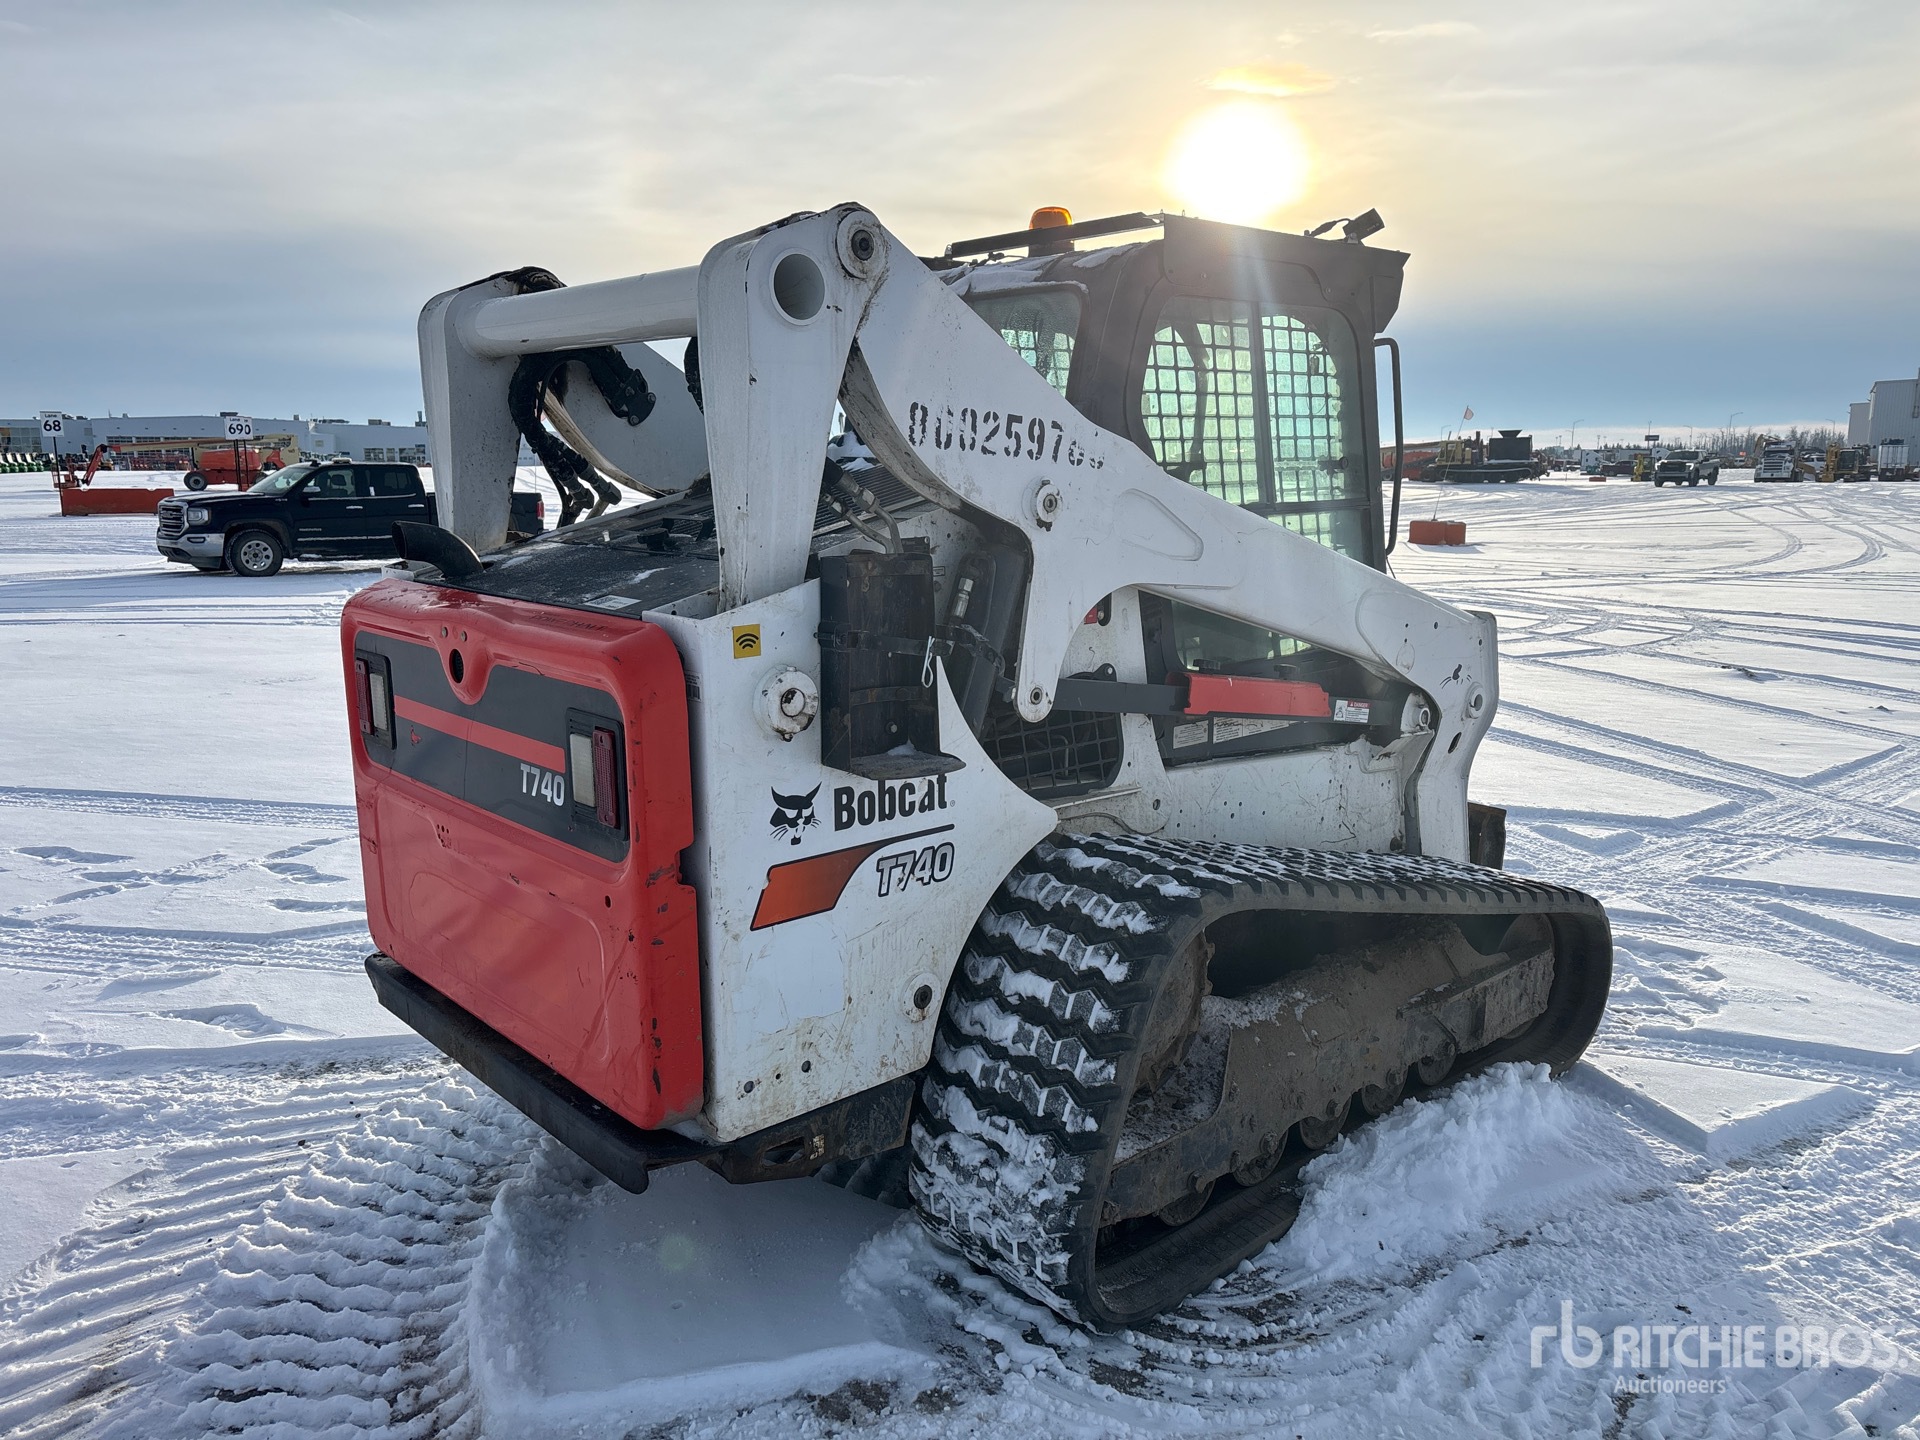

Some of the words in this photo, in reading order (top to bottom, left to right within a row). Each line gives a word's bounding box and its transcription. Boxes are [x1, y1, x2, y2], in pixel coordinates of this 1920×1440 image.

[43, 419, 62, 432] 68
[520, 763, 565, 806] T740
[834, 774, 947, 832] Bobcat
[876, 842, 955, 897] T740
